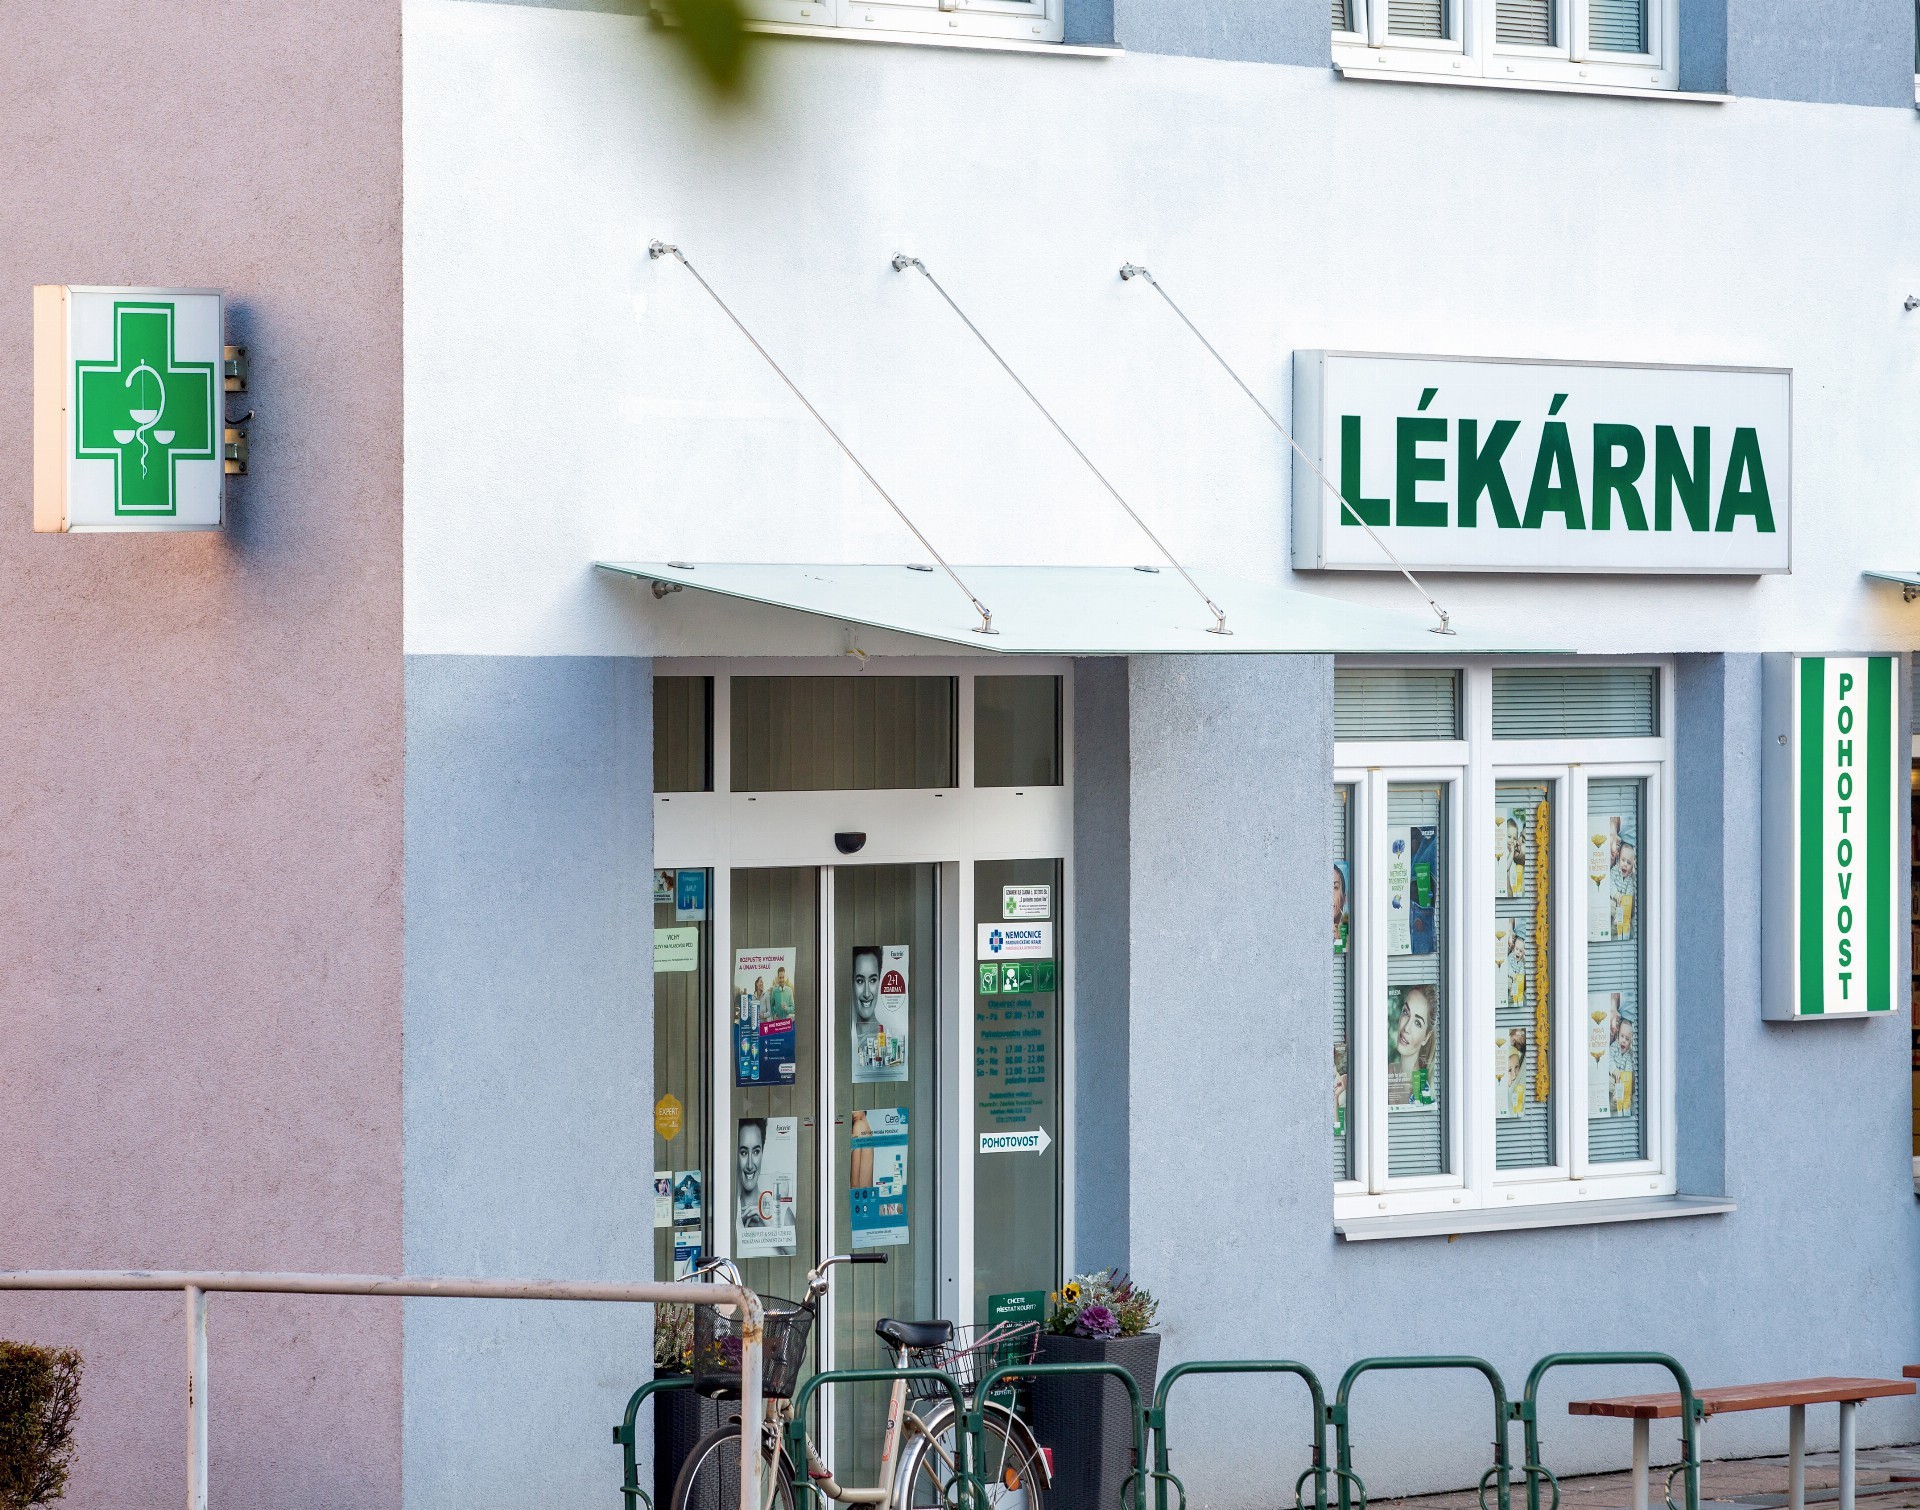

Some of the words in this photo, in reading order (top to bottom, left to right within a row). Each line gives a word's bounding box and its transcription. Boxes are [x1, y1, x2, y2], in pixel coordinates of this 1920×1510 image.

[1340, 387, 1776, 533] LÉKÁRNA
[1837, 672, 1854, 1000] POHOTOVOST
[1005, 930, 1042, 939] NEMOCNICE
[887, 974, 898, 986] 2+1
[658, 1107, 679, 1116] EXPERT
[982, 1136, 1039, 1148] POHOTOVOST
[1007, 1297, 1026, 1305] CHCETE
